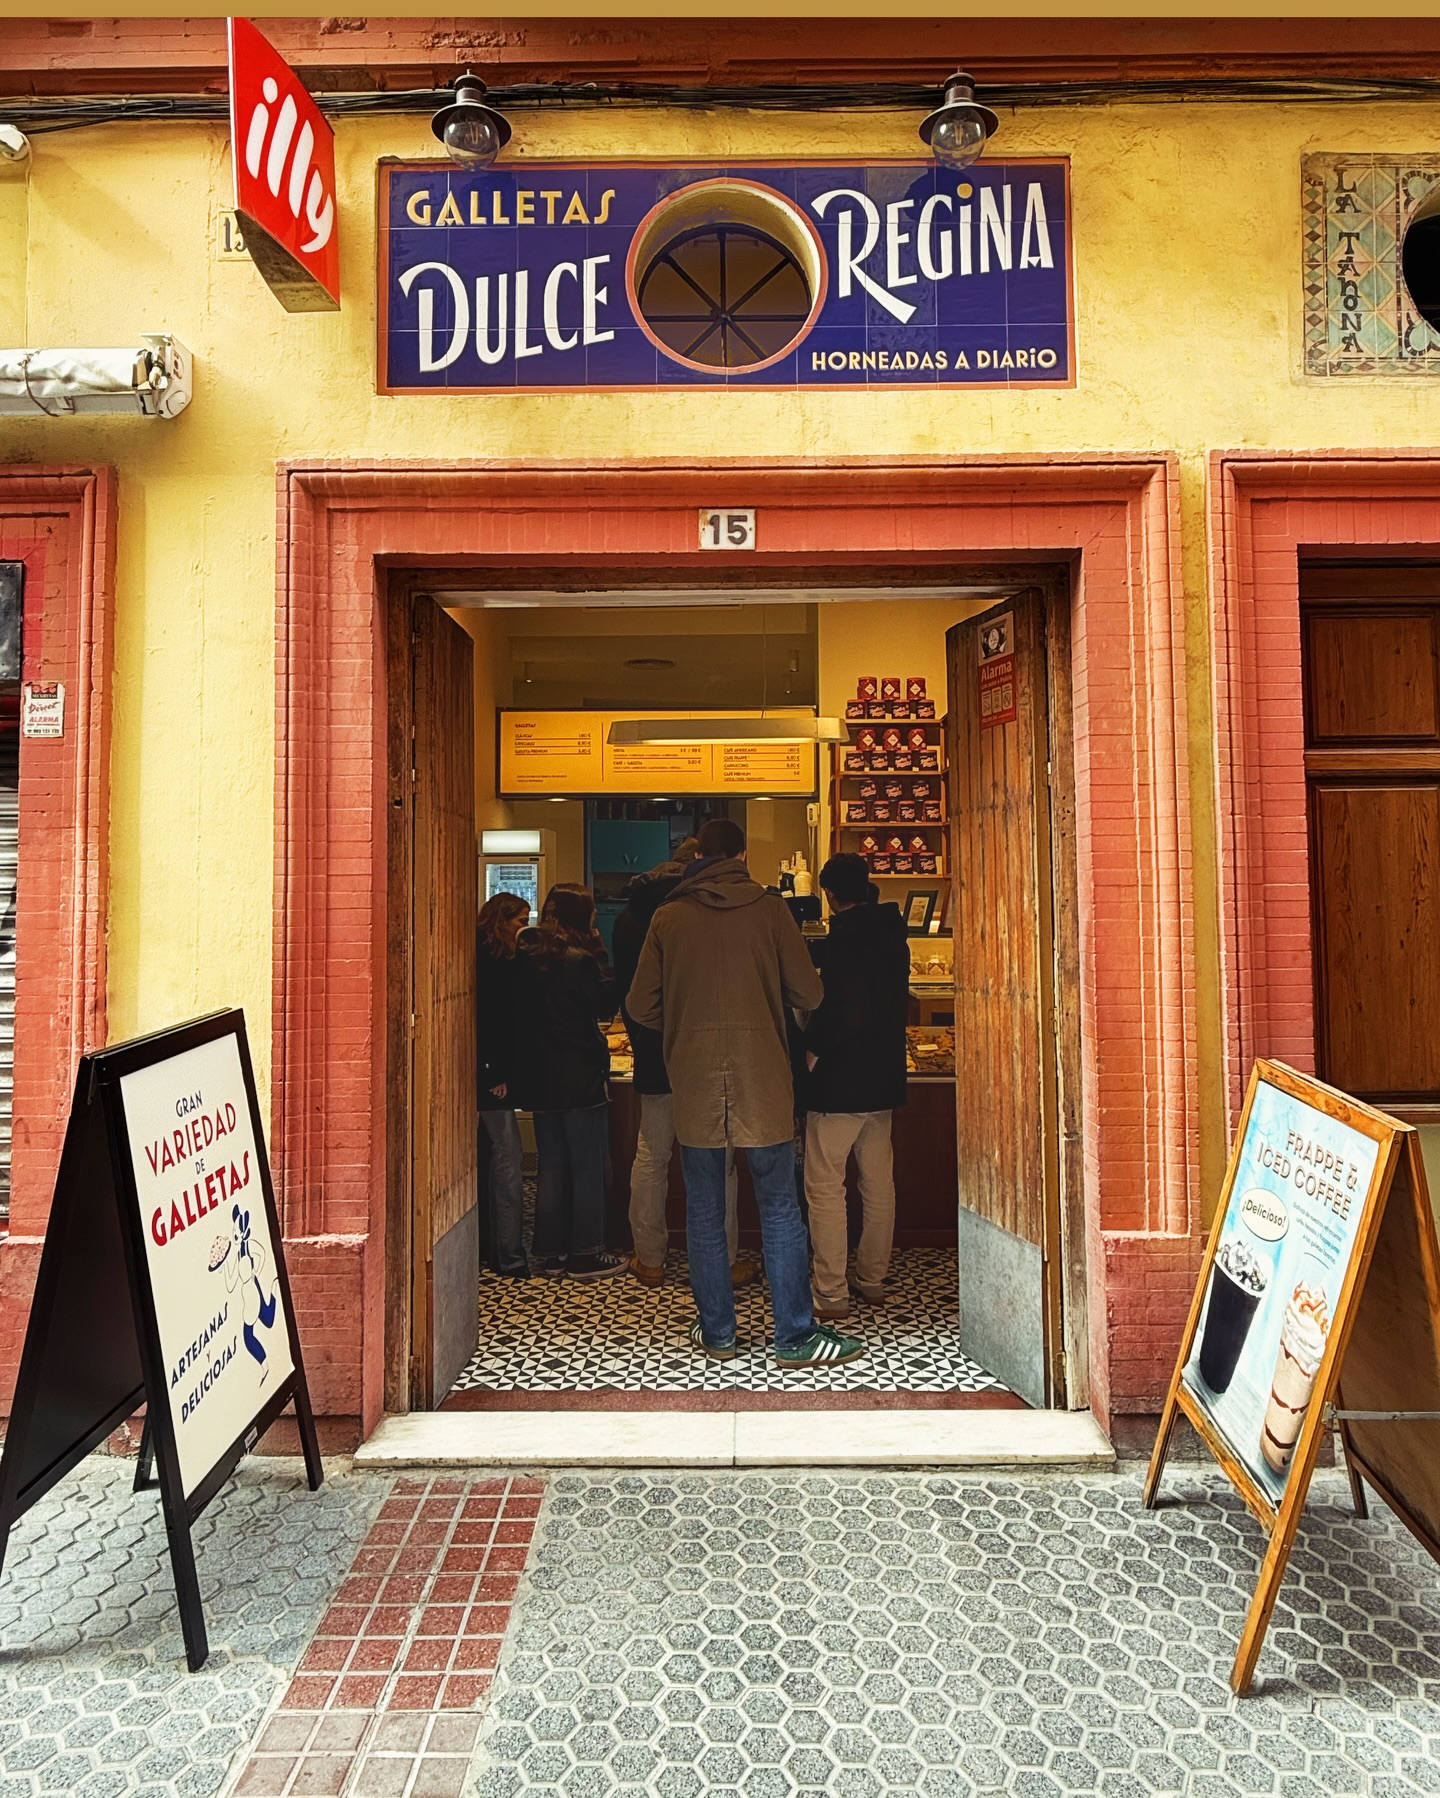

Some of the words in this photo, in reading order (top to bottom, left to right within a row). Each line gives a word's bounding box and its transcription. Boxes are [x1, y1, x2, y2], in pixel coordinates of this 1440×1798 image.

[245, 77, 334, 253] illy
[405, 189, 616, 227] GALLETAS
[1332, 167, 1362, 214] LA
[398, 254, 615, 373] DULCE
[811, 350, 948, 371] HORNEADAS
[953, 350, 971, 370] A
[709, 514, 748, 546] 15
[981, 661, 1012, 682] Alarma
[176, 1090, 203, 1118] GRAN
[144, 1102, 236, 1177] VARIEDAD
[1286, 1129, 1344, 1182] FRAPPE
[195, 1158, 205, 1175] DE
[1257, 1142, 1292, 1179] ICED
[1294, 1165, 1352, 1221] COFFEE
[151, 1150, 250, 1247] GALLETAS
[1242, 1199, 1287, 1228] ¡Delicioso!
[171, 1301, 228, 1390] ARTESANAS
[206, 1349, 211, 1363] Y
[181, 1335, 237, 1425] DELICIOSAS
